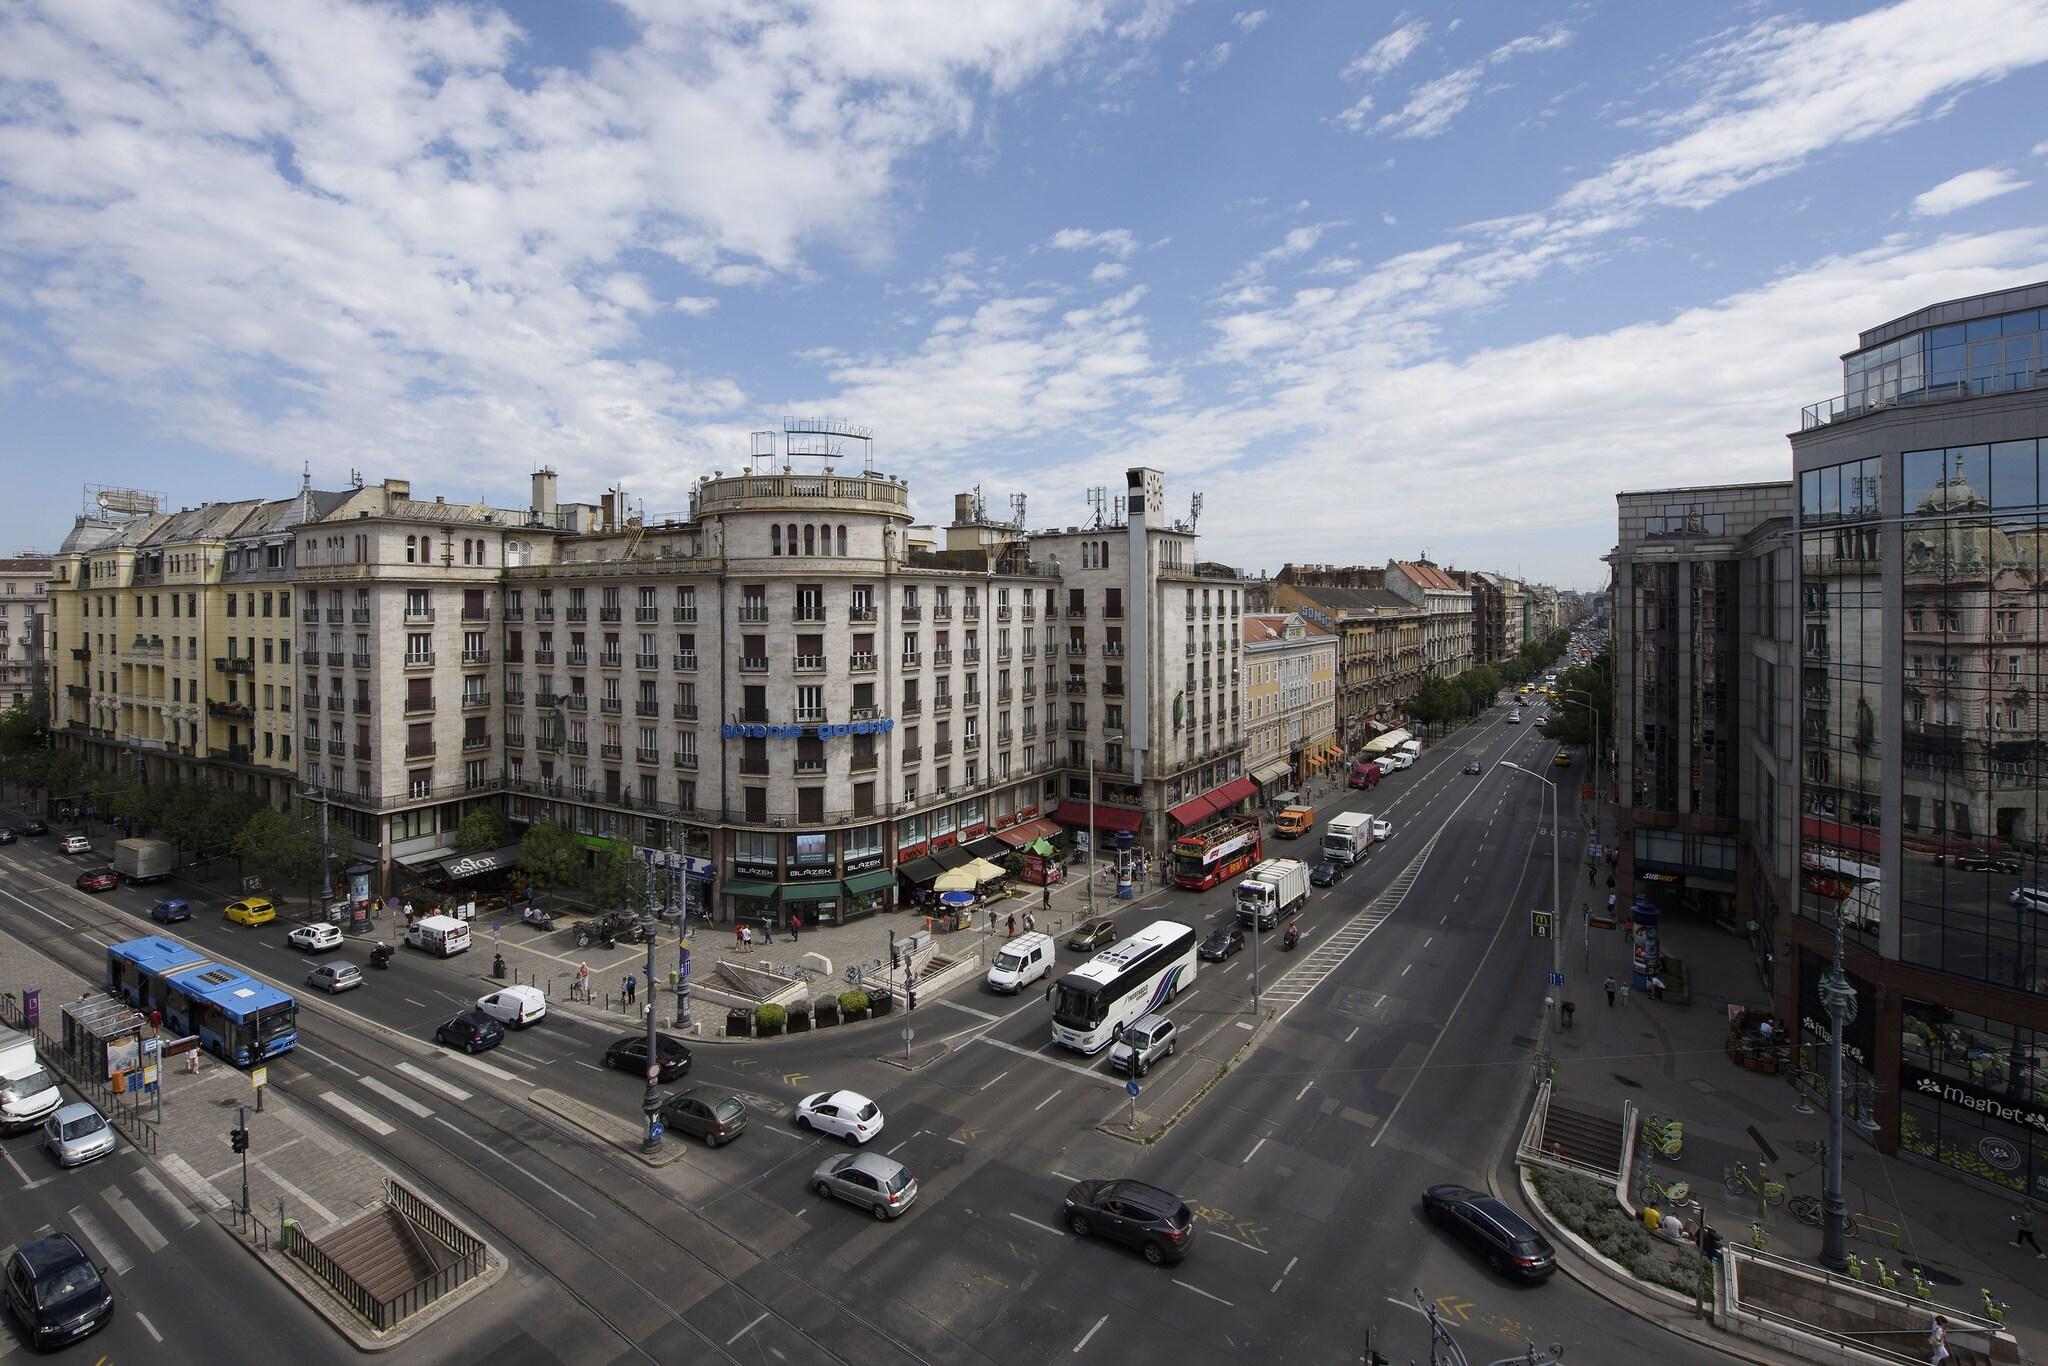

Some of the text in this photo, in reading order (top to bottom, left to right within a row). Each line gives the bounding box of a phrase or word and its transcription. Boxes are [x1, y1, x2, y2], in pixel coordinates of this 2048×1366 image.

[722, 716, 895, 742] gorenje gorenje
[1642, 871, 1678, 882] SUBWAY
